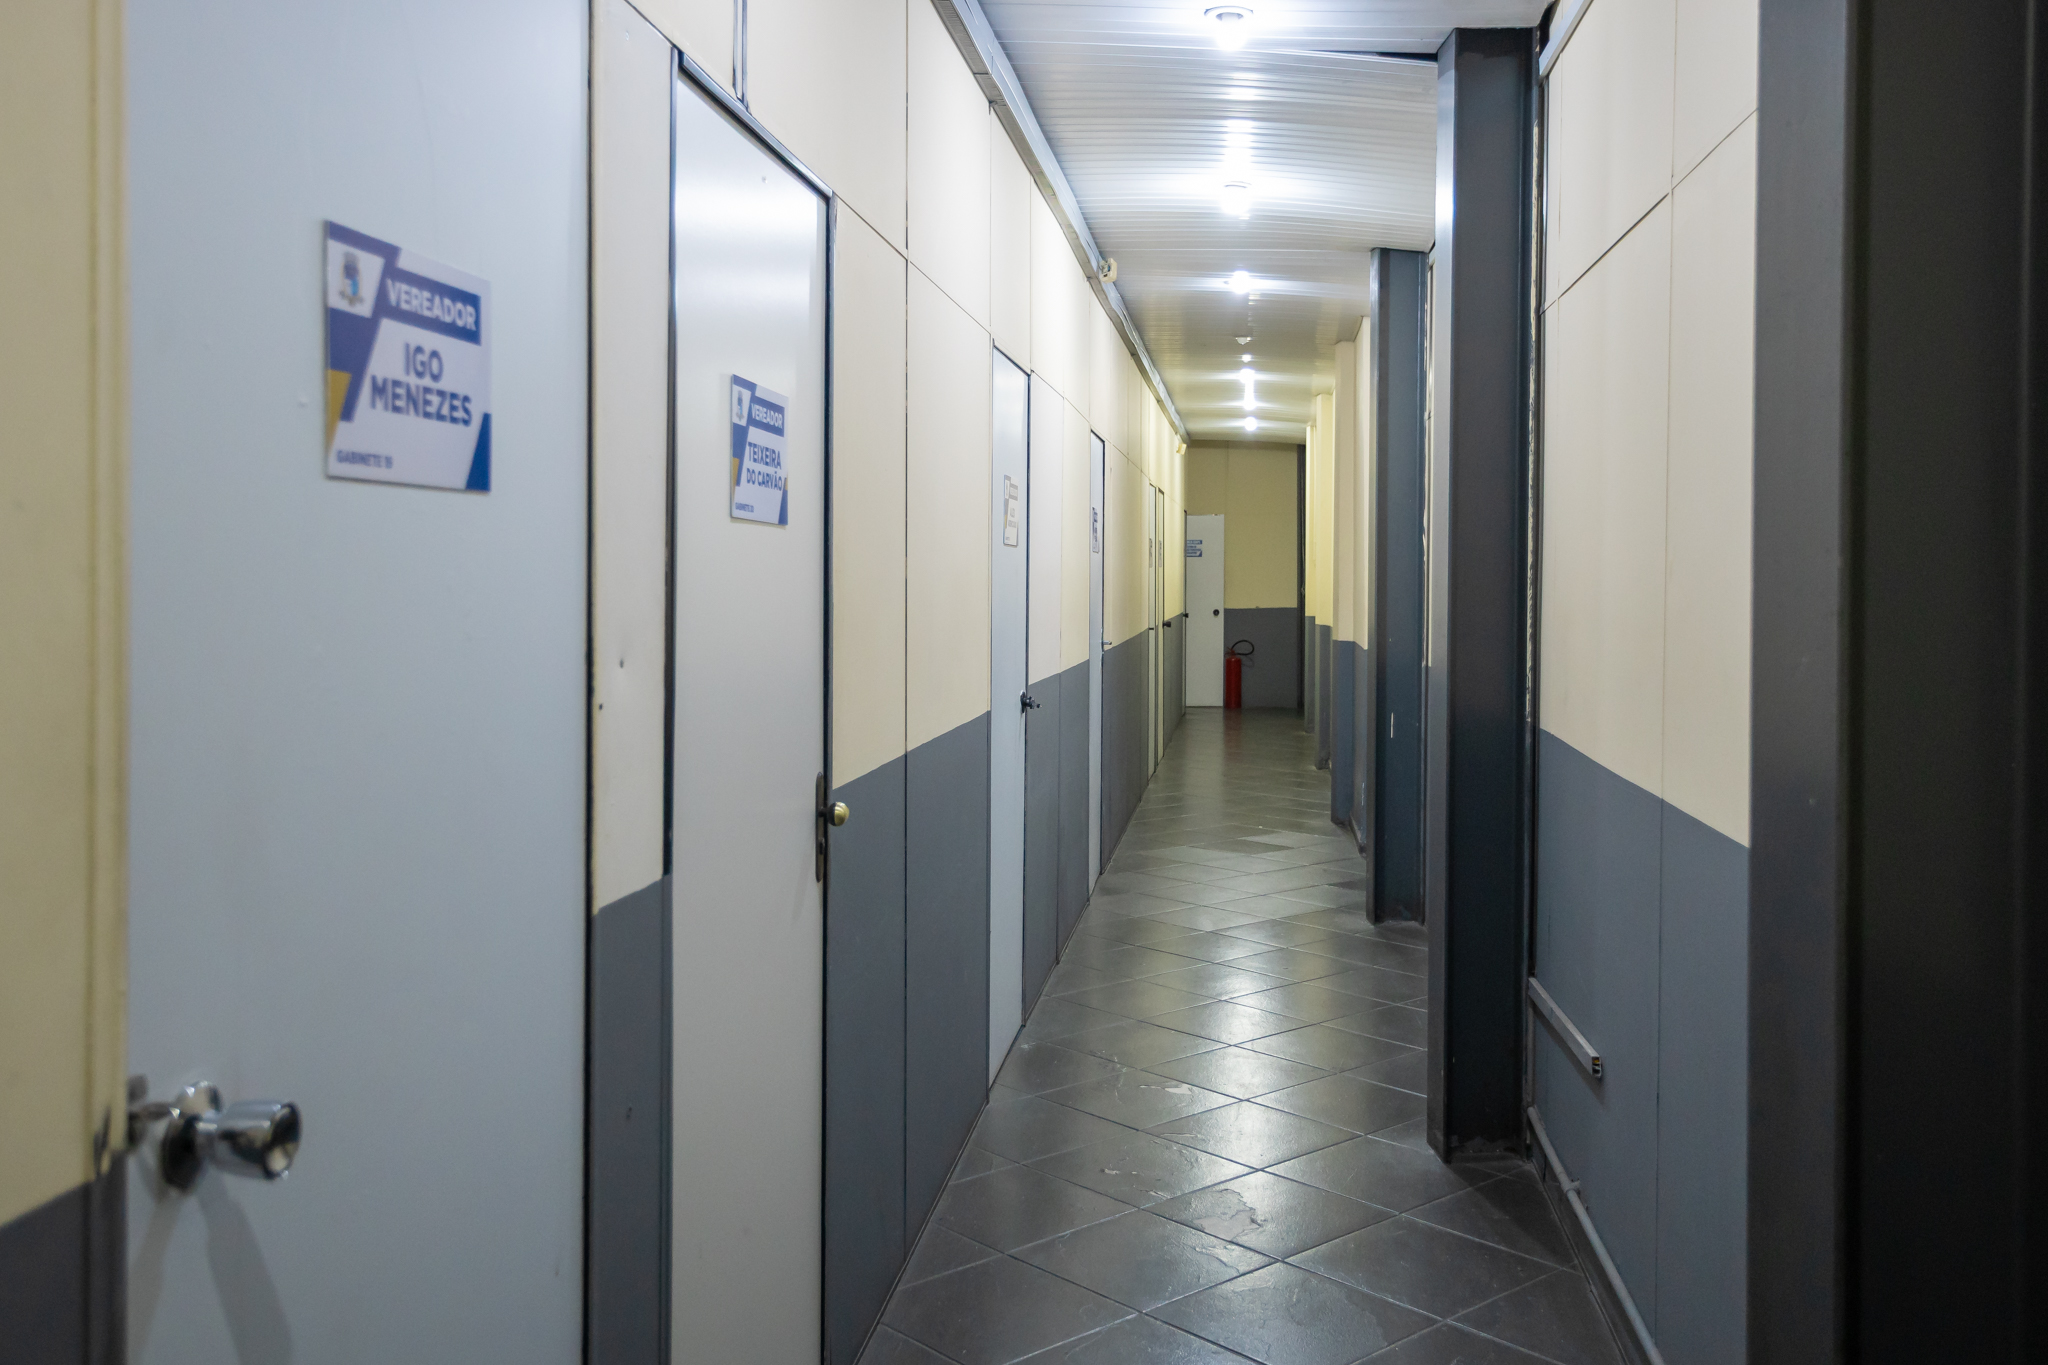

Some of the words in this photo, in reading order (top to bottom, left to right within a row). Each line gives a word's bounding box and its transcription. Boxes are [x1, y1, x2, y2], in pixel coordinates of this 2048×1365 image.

[386, 278, 477, 331] VEREADOR
[404, 343, 444, 384] IGO
[370, 375, 473, 427] MENEZES
[751, 403, 783, 429] VEREADOR
[337, 450, 382, 467] GABINETE
[748, 441, 782, 470] TEIXEIRA
[747, 468, 756, 485] DO
[757, 470, 782, 491] CARVÃO
